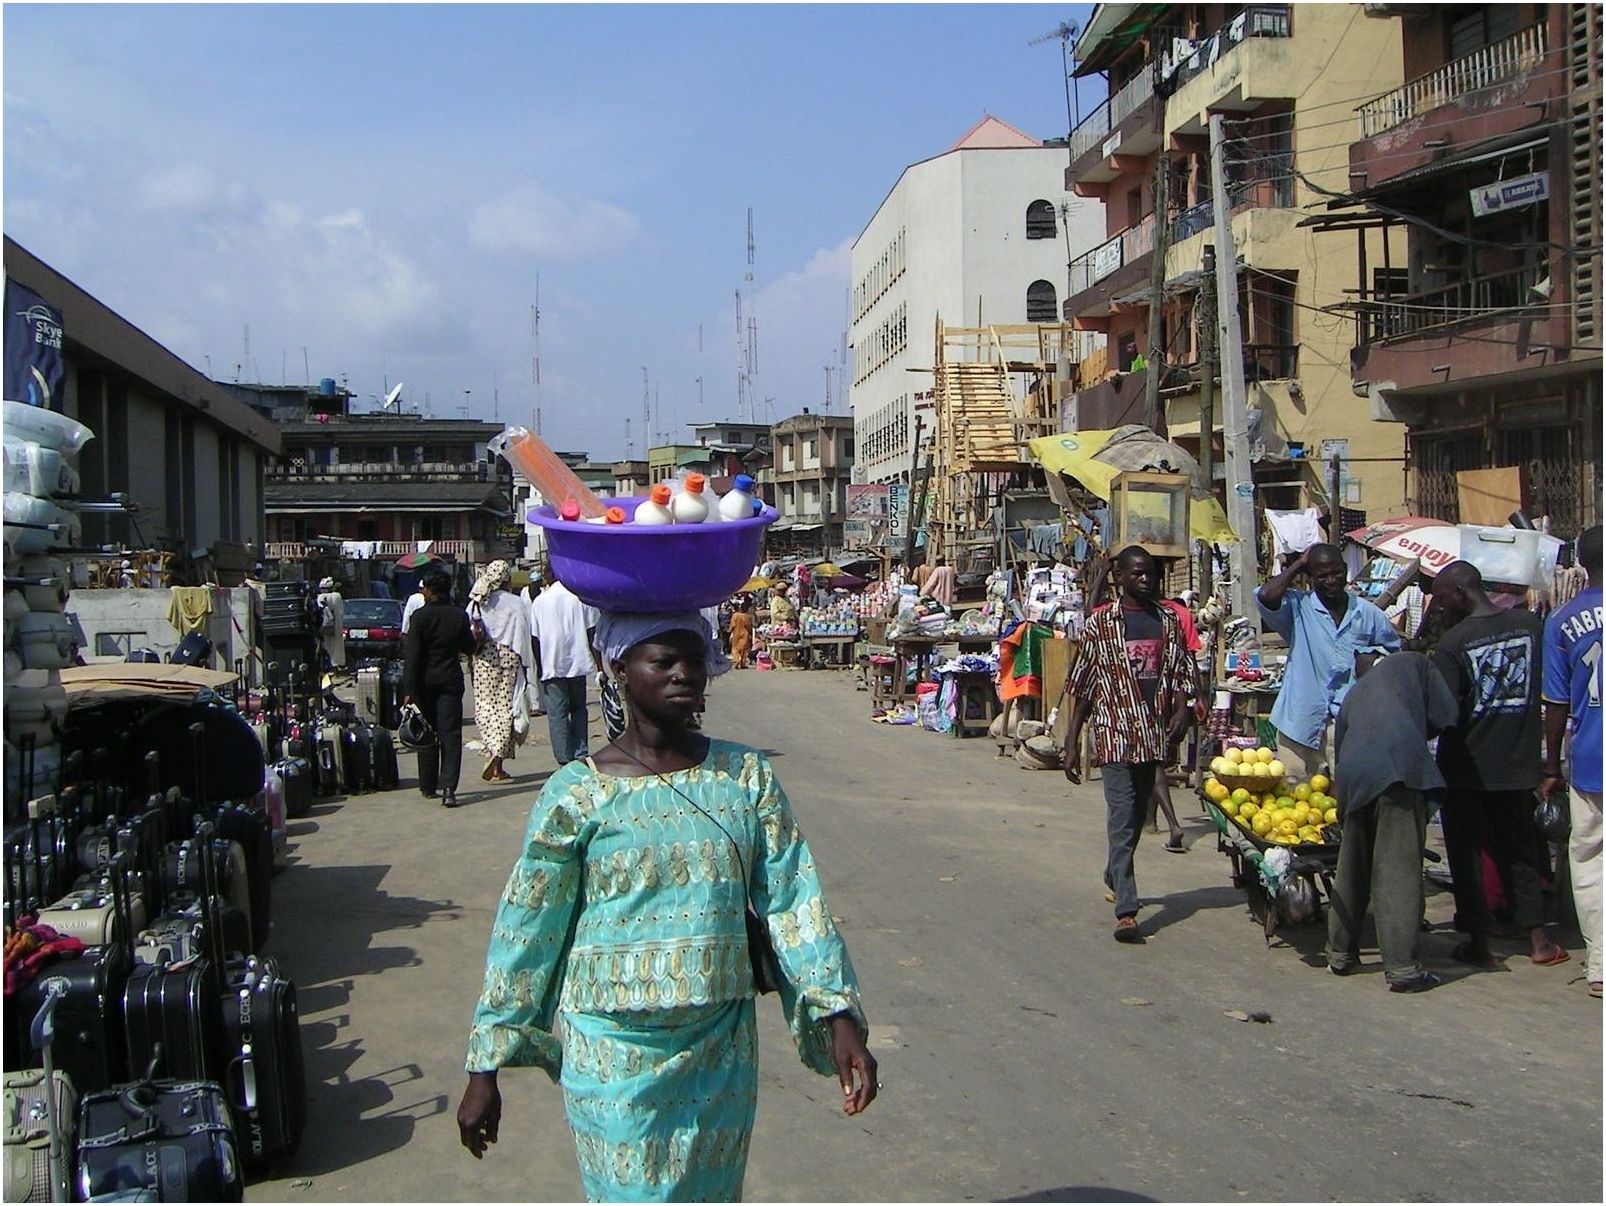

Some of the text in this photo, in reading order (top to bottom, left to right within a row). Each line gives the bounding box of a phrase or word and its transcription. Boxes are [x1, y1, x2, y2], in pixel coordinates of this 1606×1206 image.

[35, 332, 62, 349] Bank
[36, 321, 63, 339] Skye
[889, 485, 899, 537] BENKOL
[1398, 537, 1457, 567] enjoy
[1560, 606, 1603, 643] FABR
[1581, 640, 1602, 707] 1
